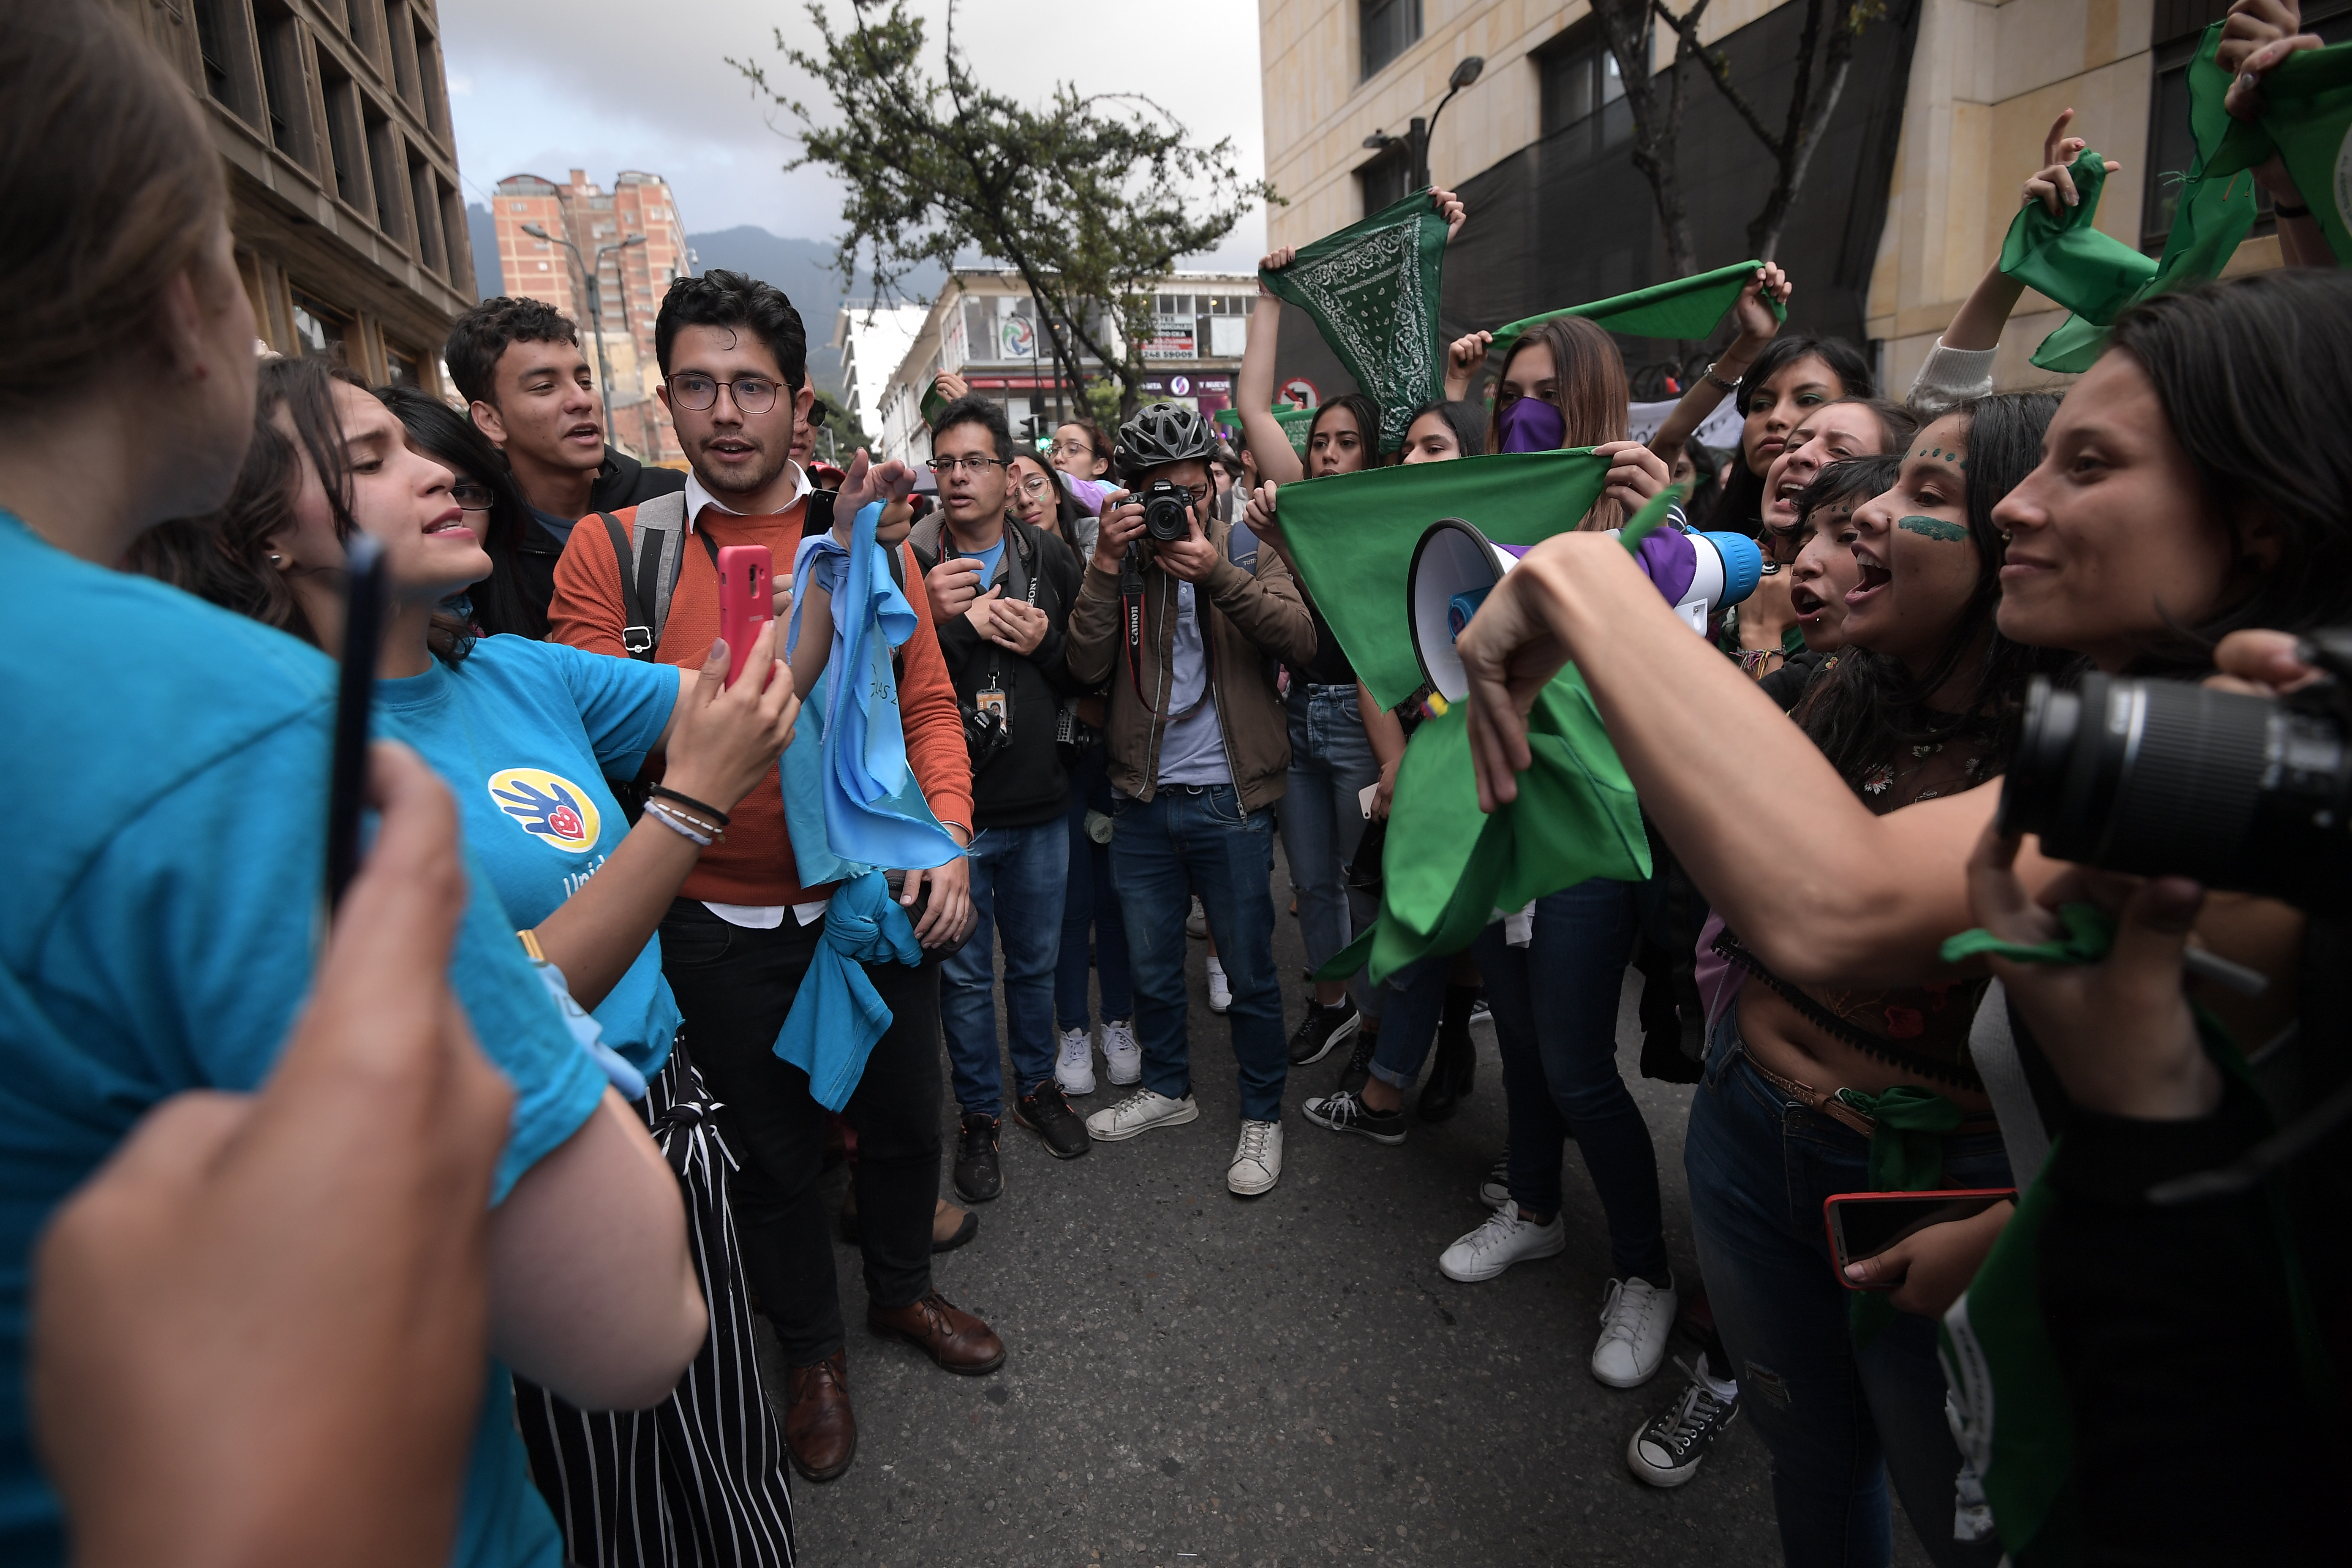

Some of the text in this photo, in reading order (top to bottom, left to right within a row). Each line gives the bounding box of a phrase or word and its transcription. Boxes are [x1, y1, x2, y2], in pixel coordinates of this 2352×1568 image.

[1027, 577, 1037, 605] SONY
[1130, 606, 1139, 646] Canon
[974, 716, 987, 729] Canon
